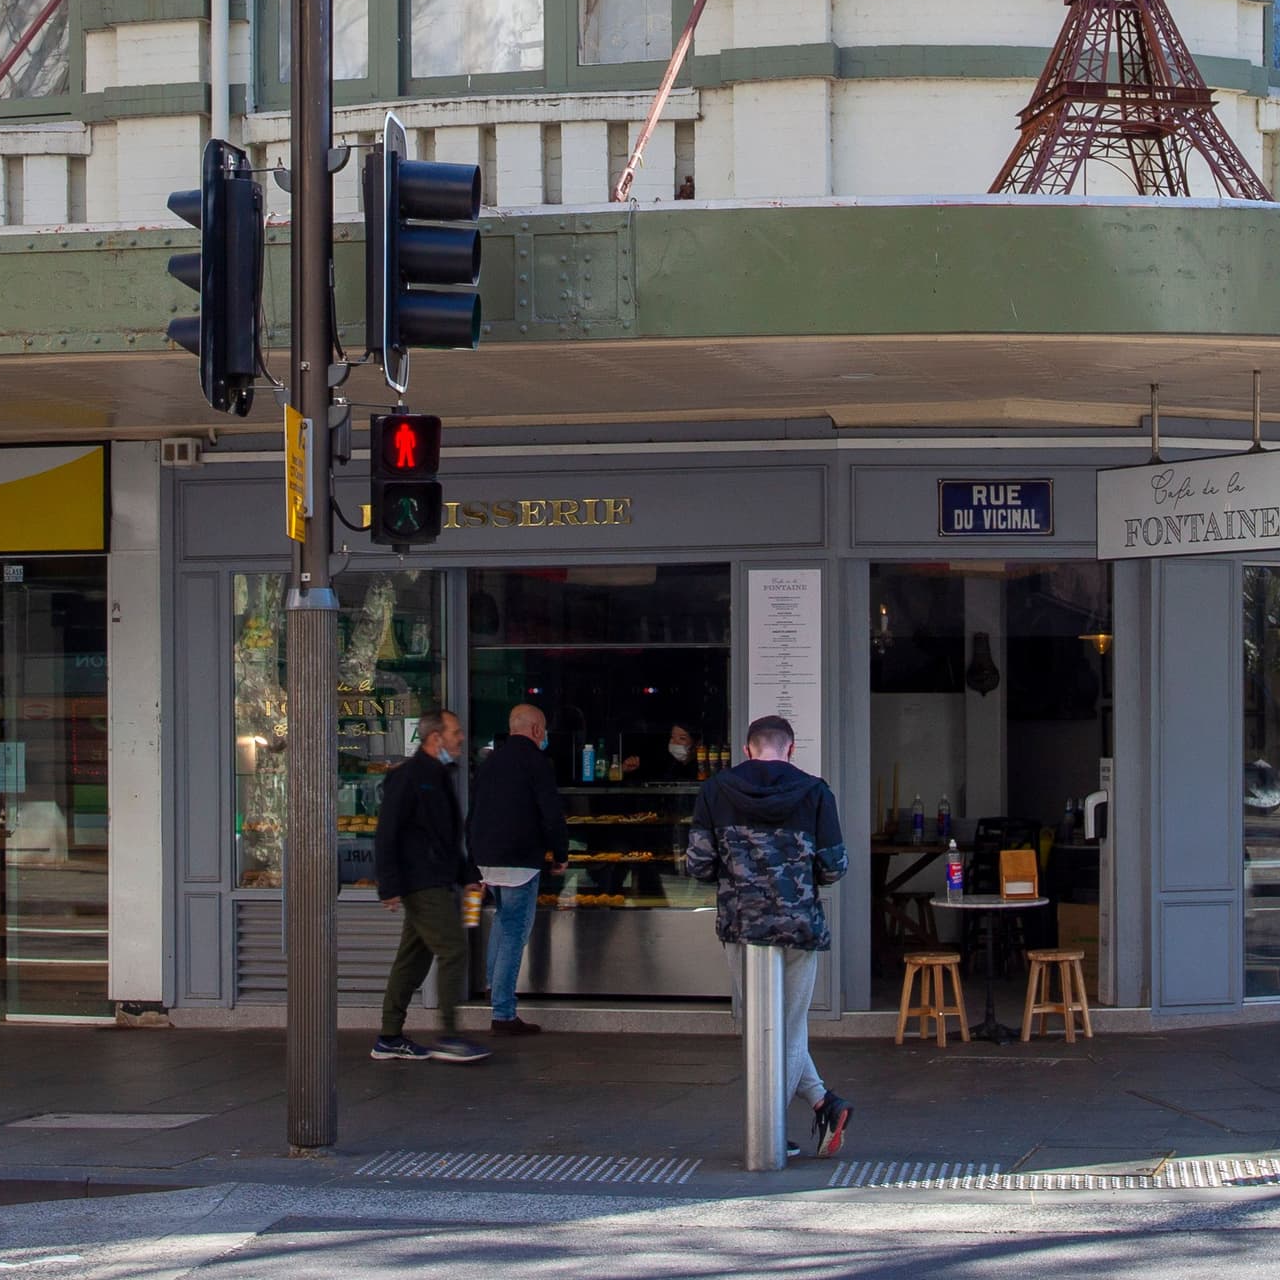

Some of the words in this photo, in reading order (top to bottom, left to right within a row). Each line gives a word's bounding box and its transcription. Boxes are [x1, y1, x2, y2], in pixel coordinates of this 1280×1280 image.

[972, 484, 1022, 506] RUE
[1151, 469, 1195, 511] Café
[1202, 478, 1219, 496] de
[1226, 472, 1246, 494] la
[358, 497, 633, 529] ISSERIE
[953, 508, 975, 530] DU
[984, 508, 1041, 530] VICINAL
[1124, 505, 1280, 548] FONTAINE
